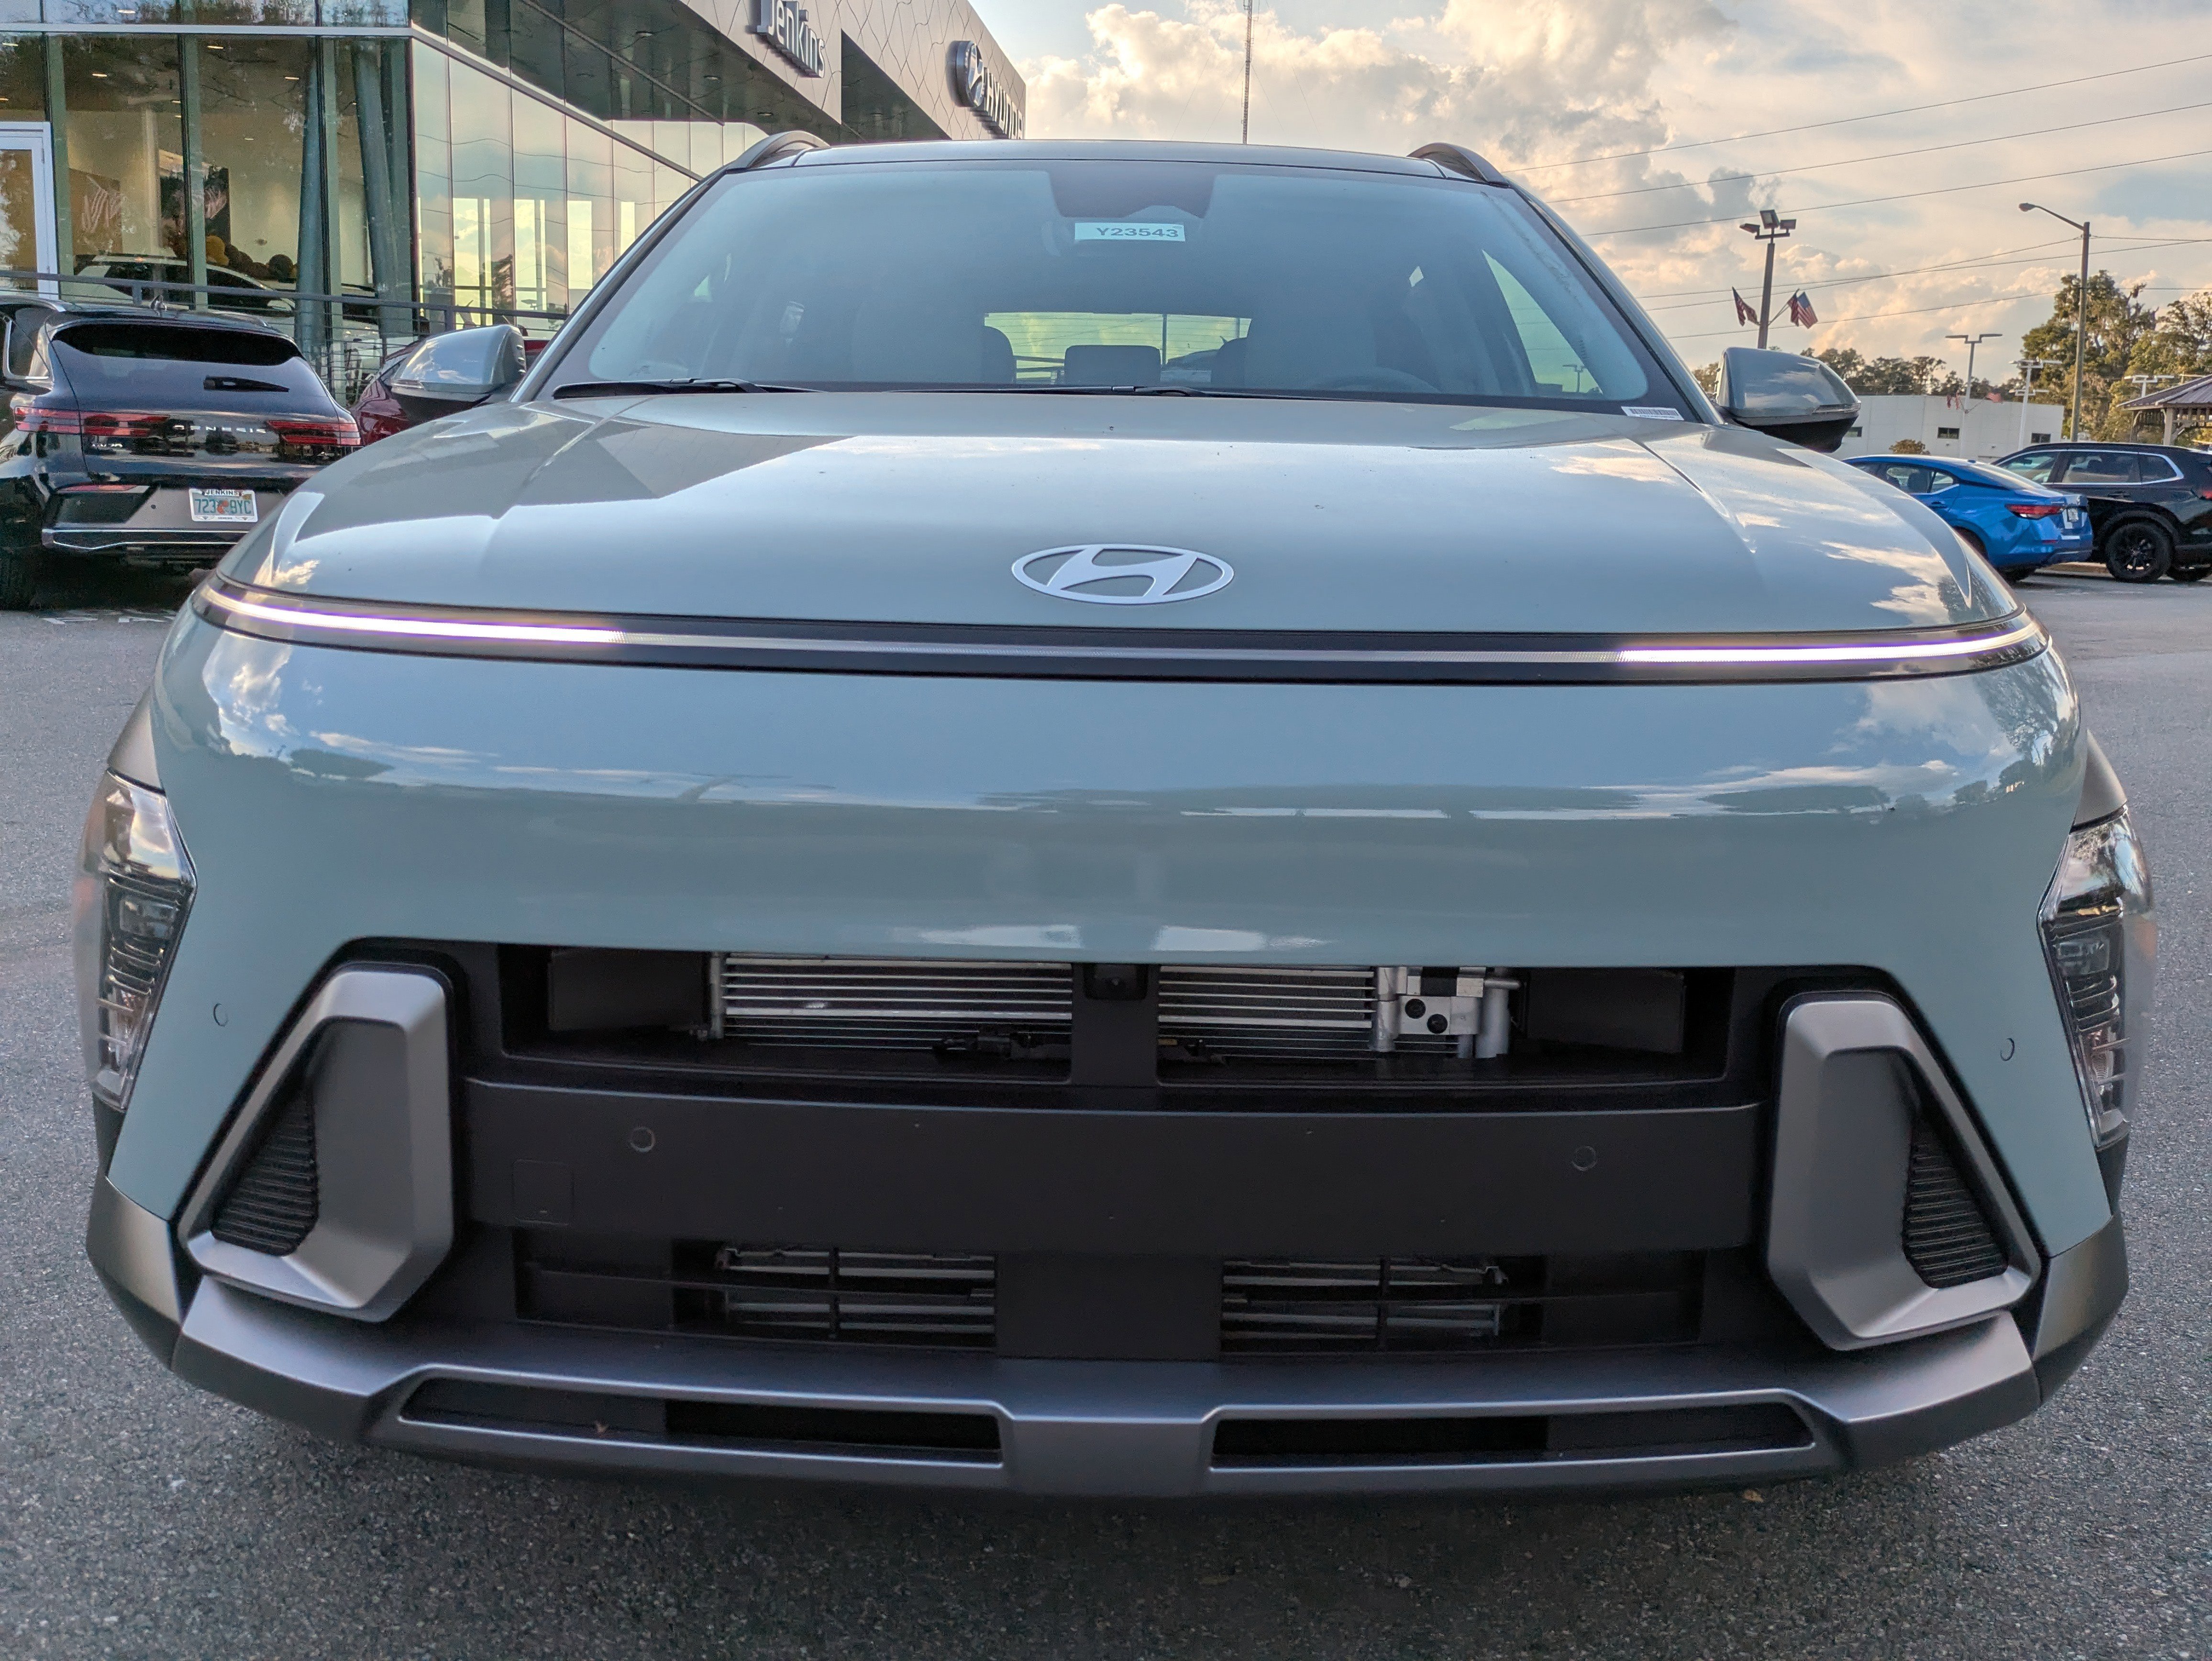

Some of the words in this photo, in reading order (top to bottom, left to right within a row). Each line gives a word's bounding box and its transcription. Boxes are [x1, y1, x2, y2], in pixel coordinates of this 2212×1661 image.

[1096, 227, 1179, 238] Y23543
[172, 425, 266, 433] GENESIS
[194, 498, 216, 514] 723
